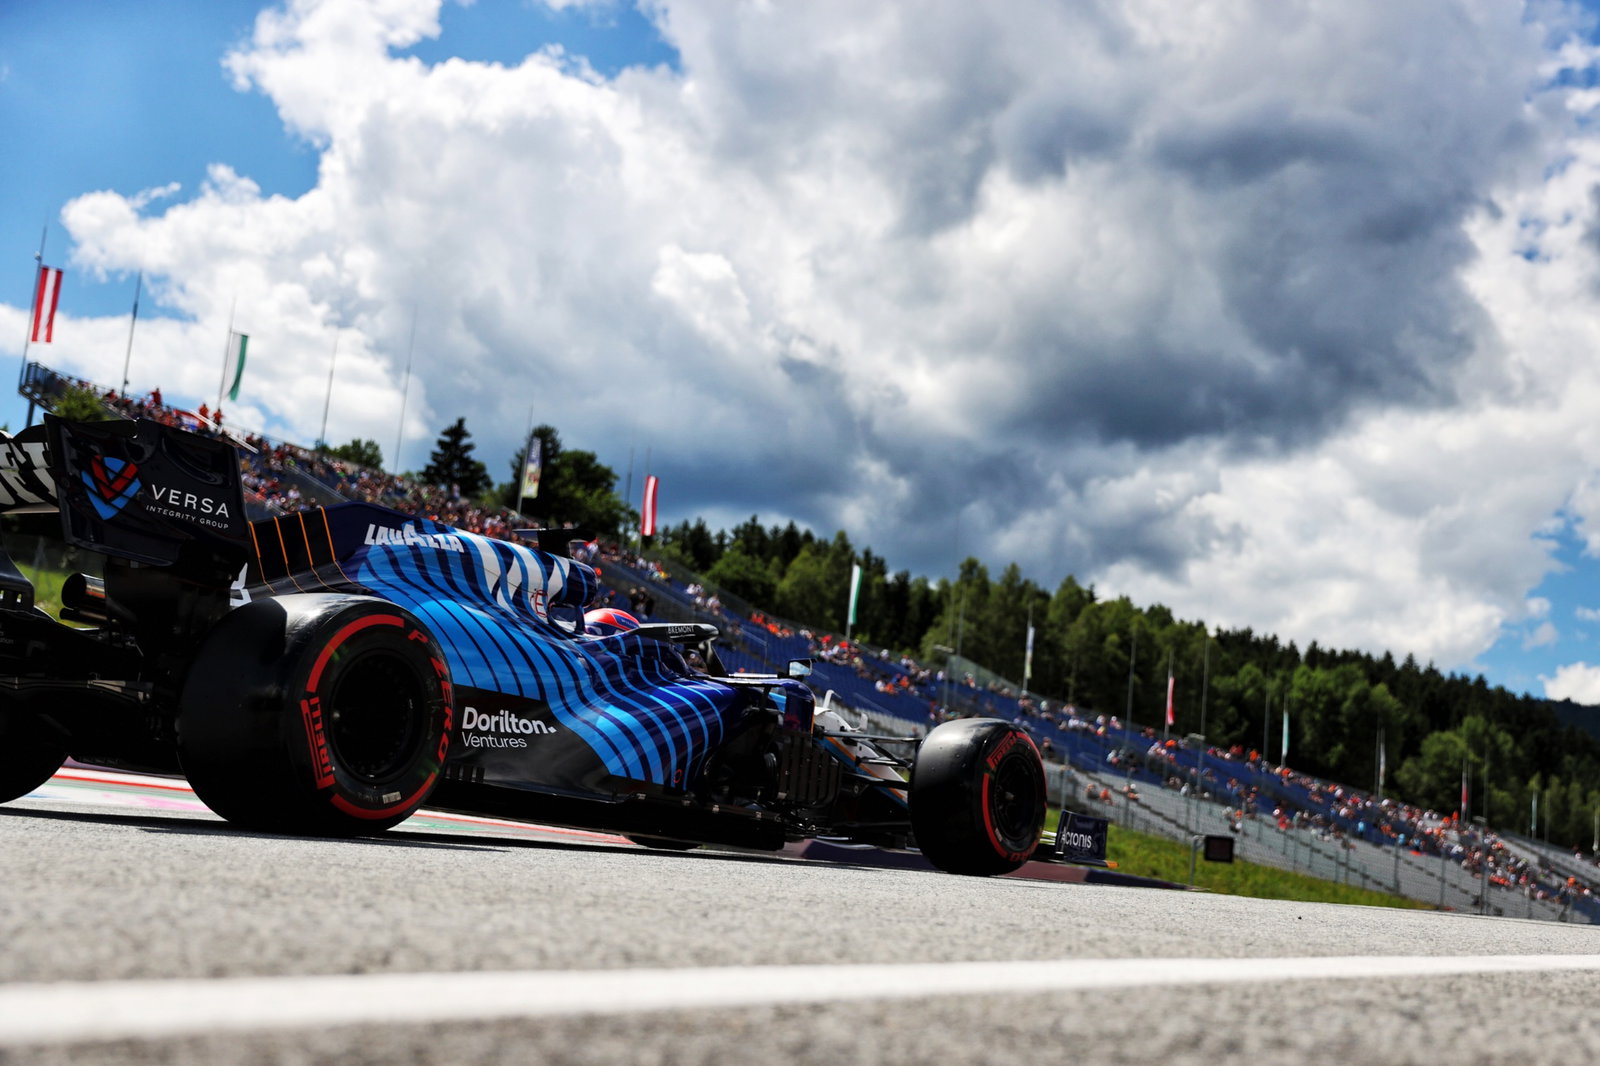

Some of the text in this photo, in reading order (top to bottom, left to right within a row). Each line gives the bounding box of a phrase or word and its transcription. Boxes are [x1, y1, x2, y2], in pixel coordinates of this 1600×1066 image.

[152, 484, 229, 518] VERSA
[146, 505, 229, 529] INTEGRITY GROUP
[364, 523, 465, 553] LAVAZZA
[667, 625, 695, 636] BREMONT
[408, 629, 428, 643] P
[430, 656, 453, 763] ZERO
[301, 696, 336, 790] PIRELLI
[461, 731, 528, 748] Ventures
[1061, 827, 1092, 849] Acronis
